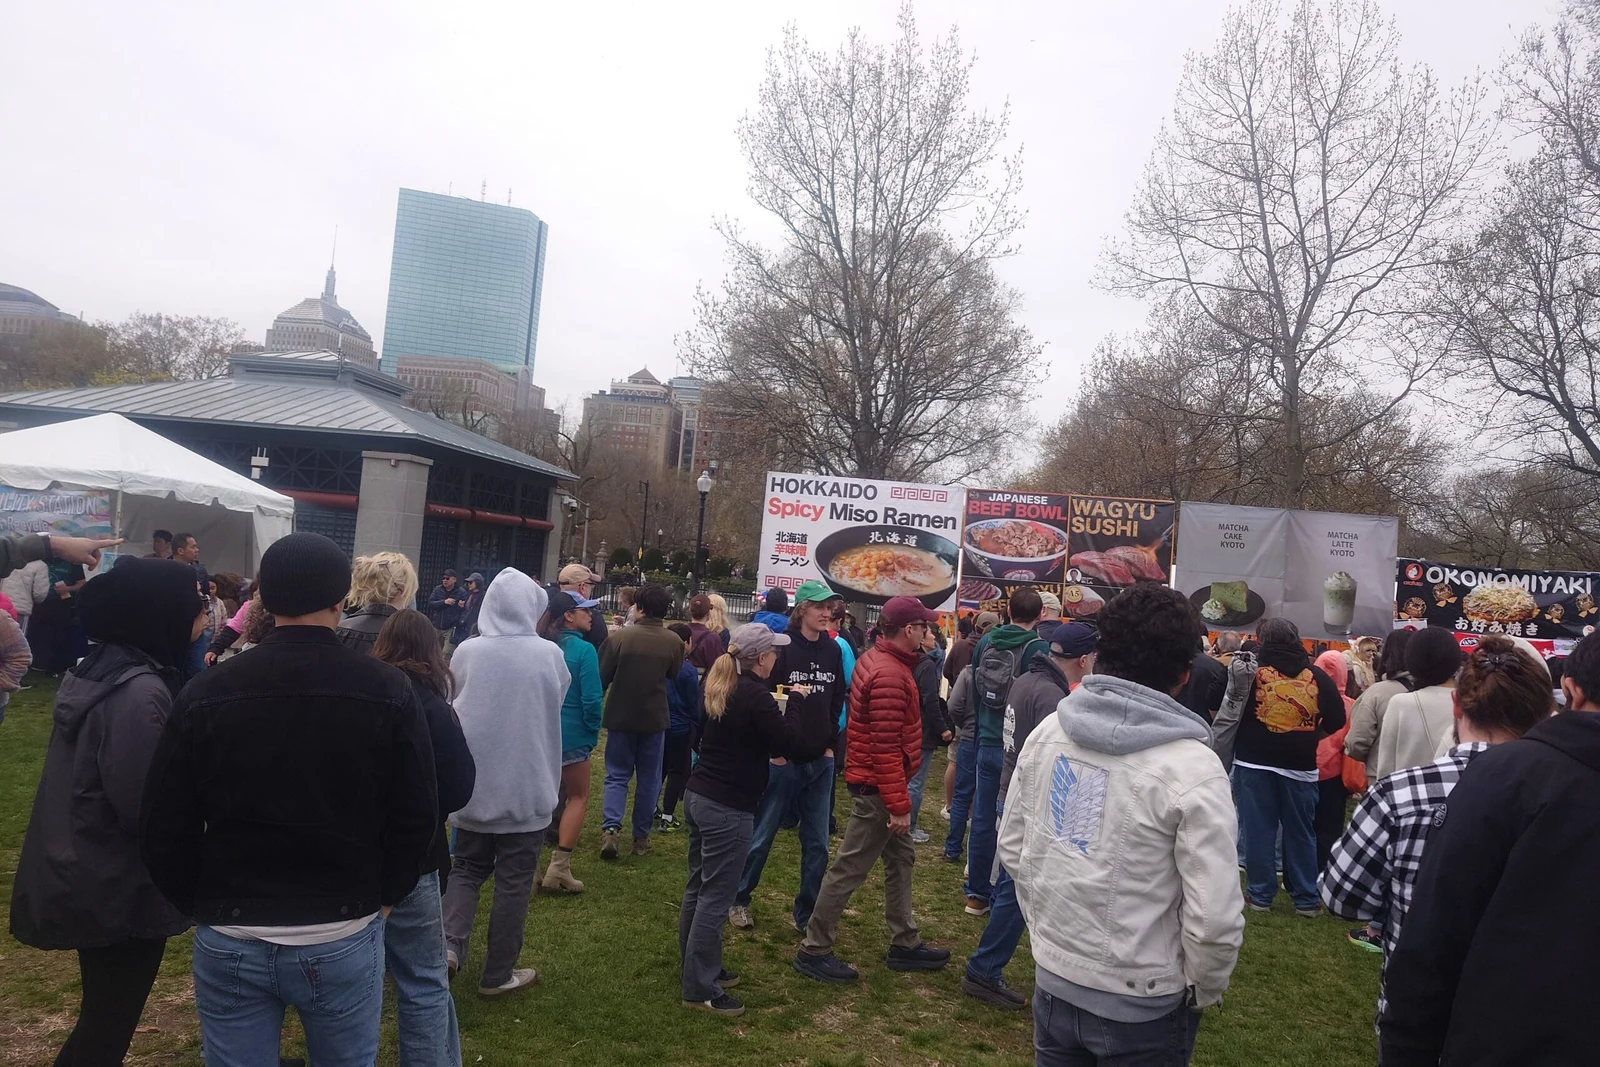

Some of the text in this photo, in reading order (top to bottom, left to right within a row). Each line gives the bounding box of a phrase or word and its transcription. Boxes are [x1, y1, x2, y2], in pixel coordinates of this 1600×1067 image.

[771, 477, 878, 500] HOKKAIDO
[38, 494, 97, 515] STATION
[989, 493, 1048, 505] JAPANESE
[768, 497, 957, 530] Spicy Miso Ramen
[968, 500, 1067, 520] BEEF BOWL
[1072, 499, 1156, 521] WAGYU
[7, 516, 50, 533] Recycle
[1071, 516, 1139, 538] SUSHI
[1218, 523, 1249, 532] MATCHA
[775, 531, 808, 545] 北海道
[869, 531, 918, 547] 北海道
[1223, 532, 1243, 541] CAKE
[1327, 531, 1359, 540] MATCHA
[1220, 541, 1245, 550] KYOTO
[1331, 540, 1354, 549] LATTE
[770, 554, 809, 567] ラーメン
[1329, 549, 1355, 558] KYOTO
[1425, 566, 1592, 595] OKONOMIYAKI
[1455, 616, 1539, 637] お好み焼き
